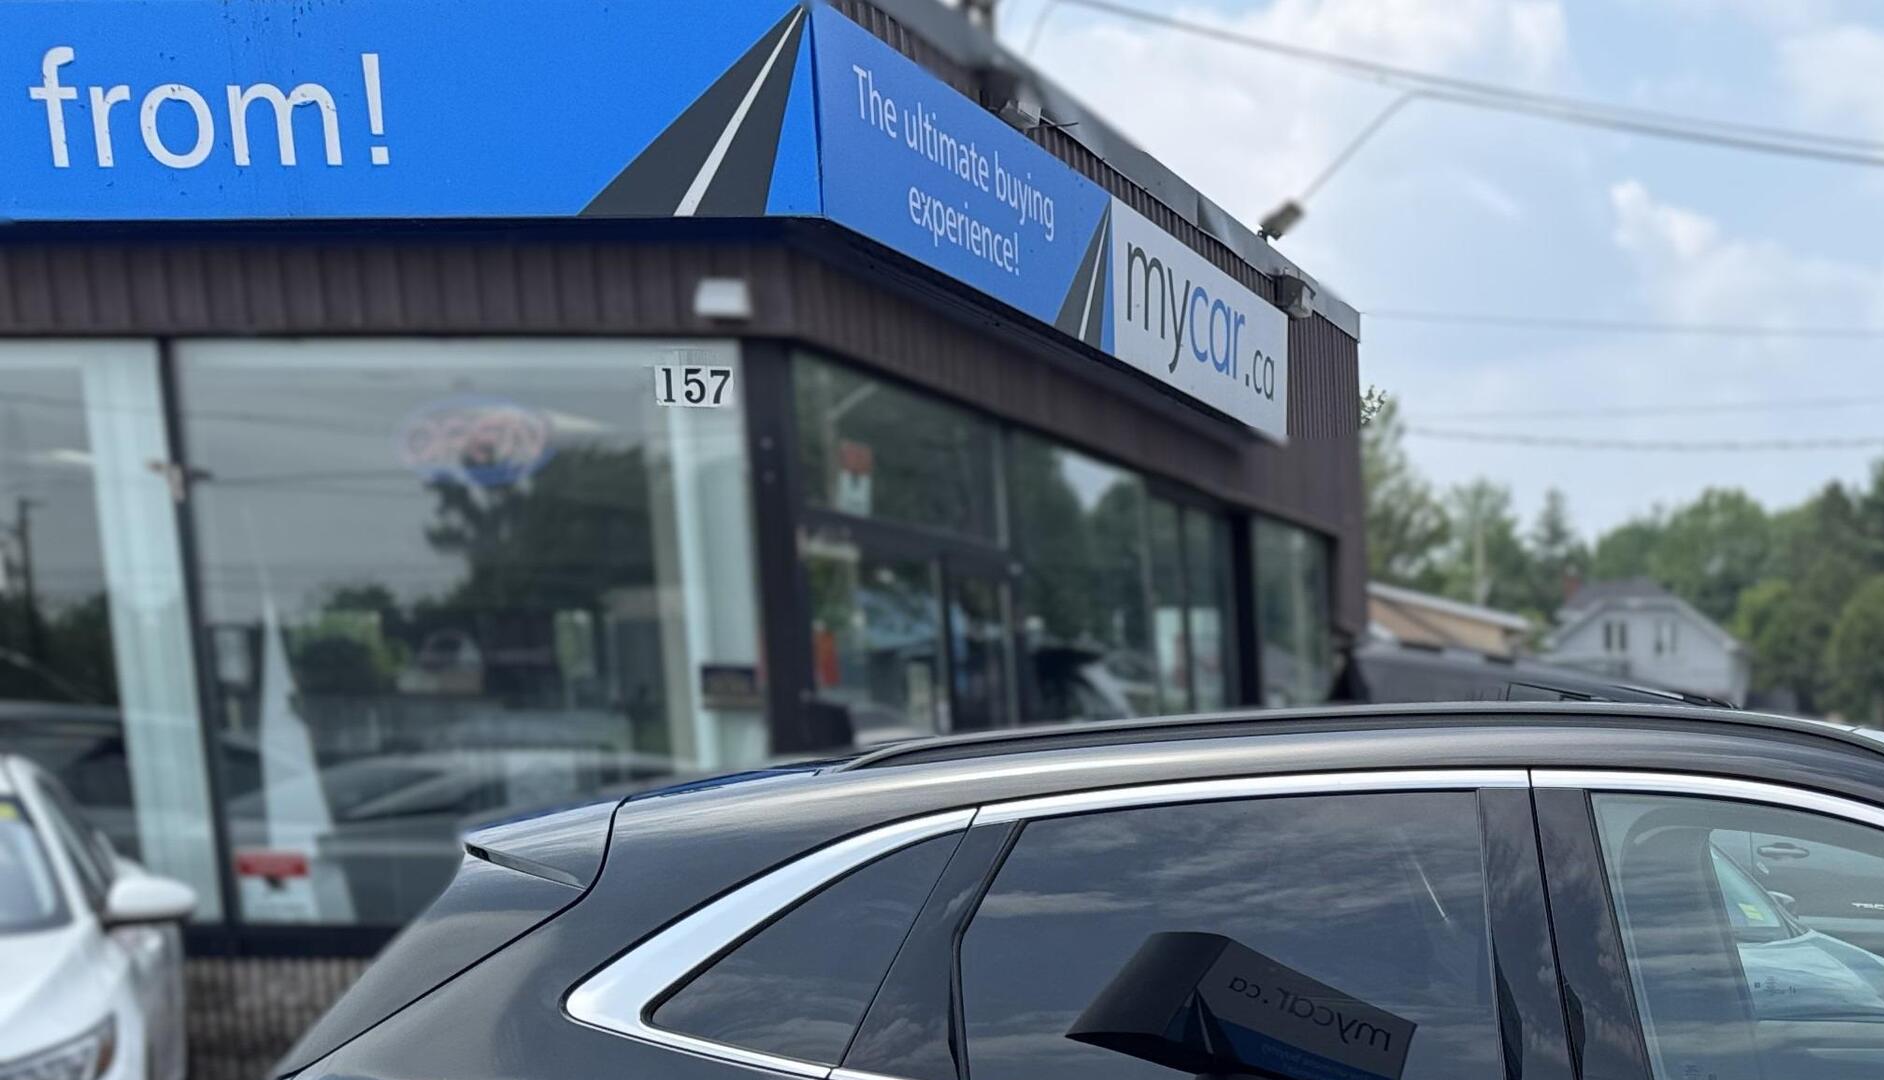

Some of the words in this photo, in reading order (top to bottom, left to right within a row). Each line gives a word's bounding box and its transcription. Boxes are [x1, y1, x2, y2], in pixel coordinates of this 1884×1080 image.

[29, 46, 390, 169] from!
[853, 64, 897, 138] The
[904, 102, 989, 192] ultimate
[994, 151, 1054, 242] buying
[909, 186, 1019, 276] experience!
[1127, 242, 1274, 401] mycar.ca
[662, 368, 730, 404] 157
